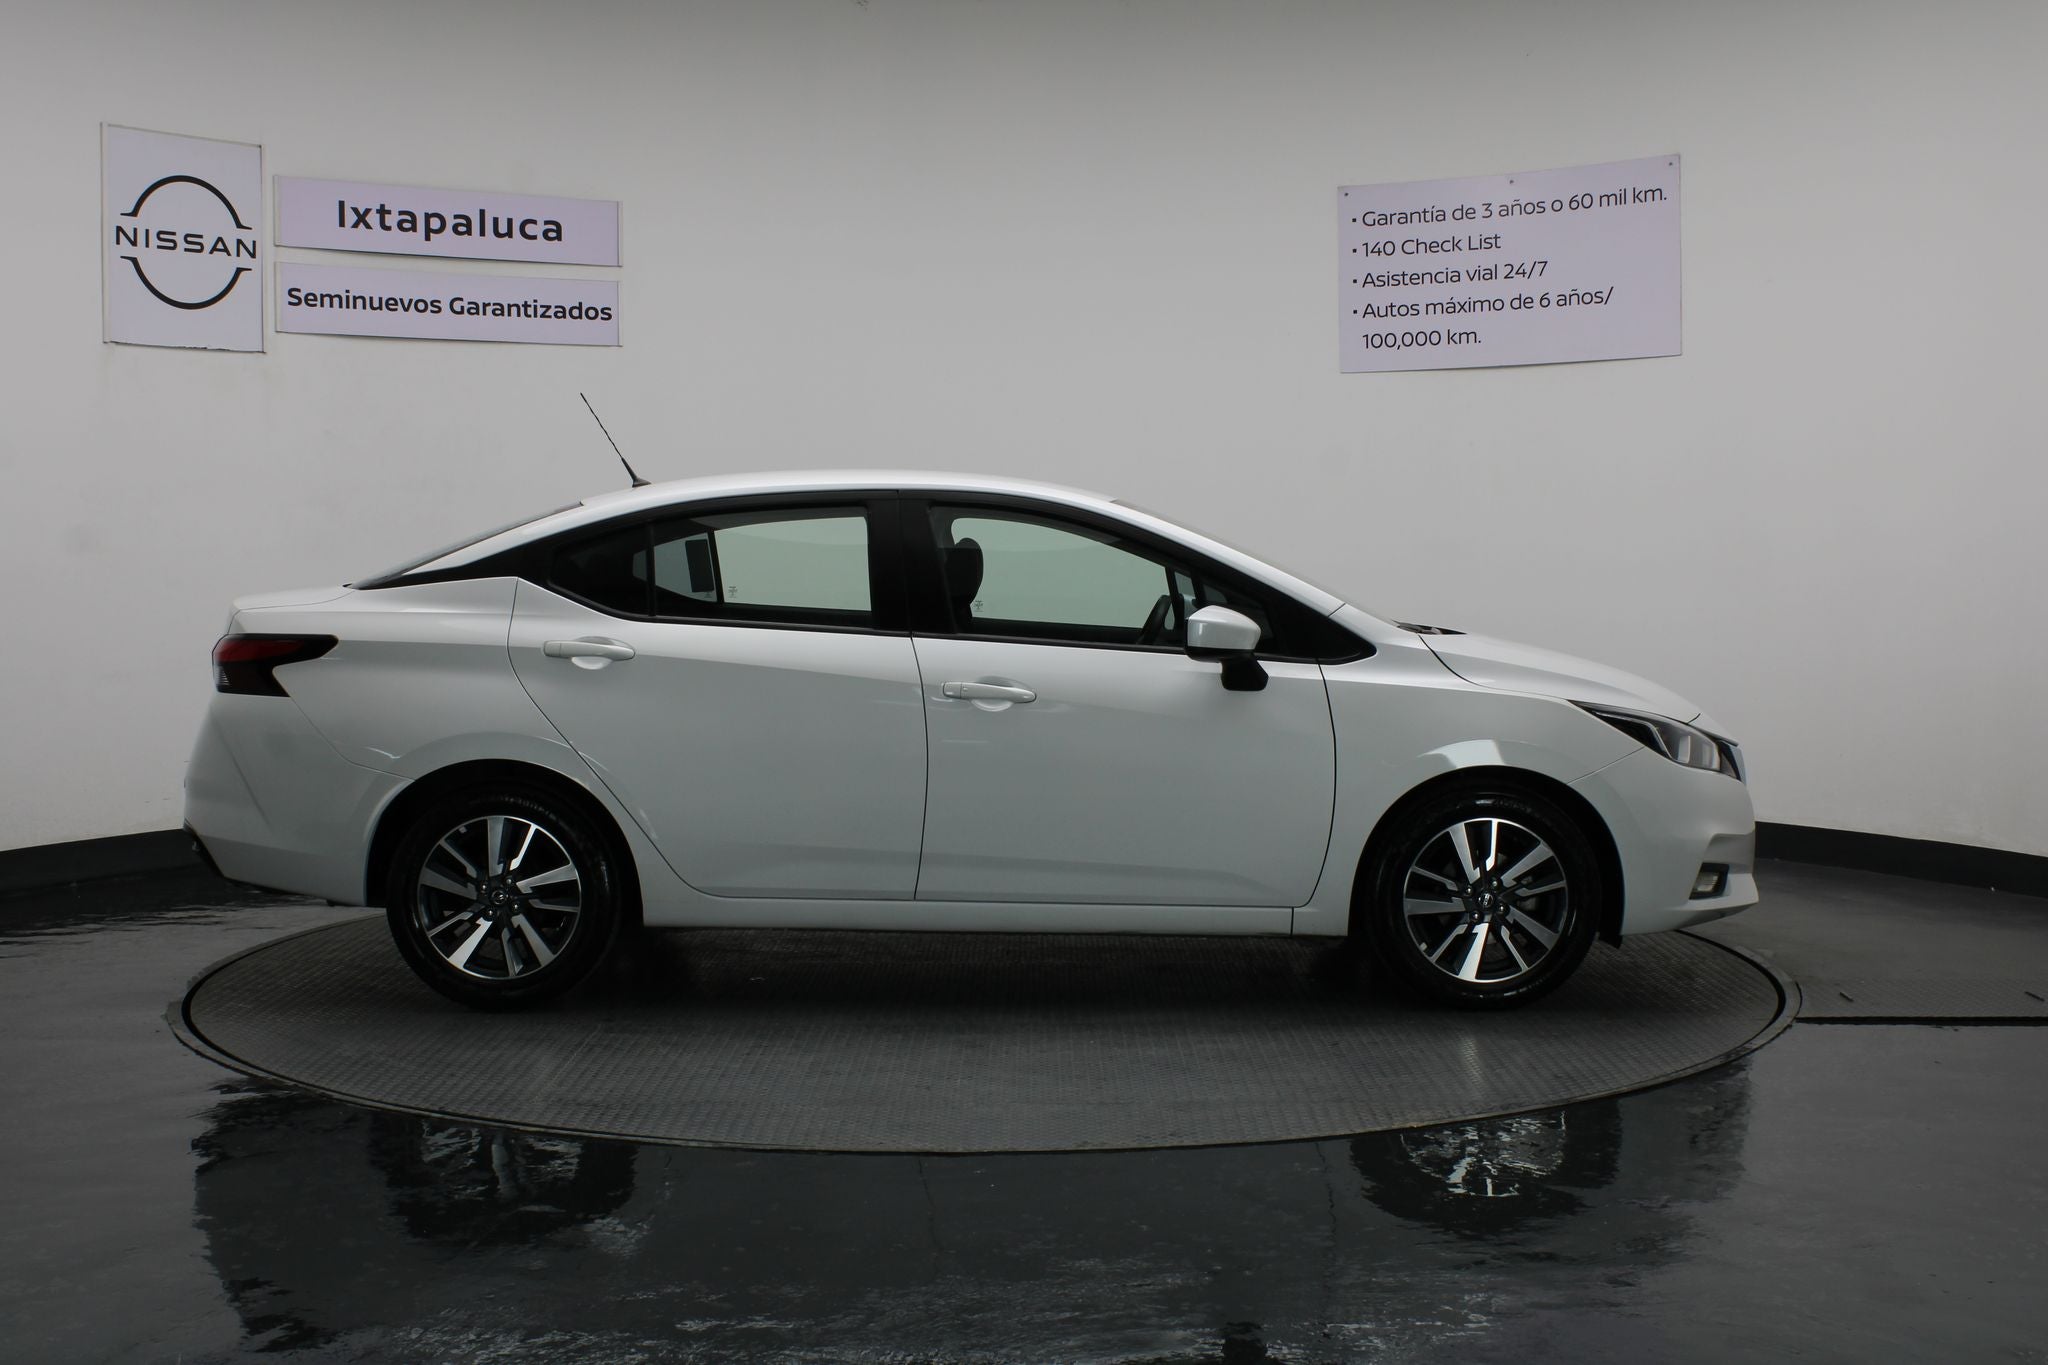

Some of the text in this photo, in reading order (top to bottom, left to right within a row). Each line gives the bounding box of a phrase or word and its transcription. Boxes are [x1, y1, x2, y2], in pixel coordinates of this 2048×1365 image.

[338, 199, 563, 242] Ixtapaluca
[1361, 186, 1668, 227] Garantía de 3 años o 60 mil km.
[115, 225, 257, 260] NISSAN
[1361, 233, 1502, 258] 140 Check List
[1361, 260, 1549, 289] Asistencia vial 24/7
[287, 287, 613, 322] Seminuevos Garantizados
[1362, 285, 1615, 319] Autos máximo de 6 años/
[1362, 328, 1482, 351] 100,000 km.
